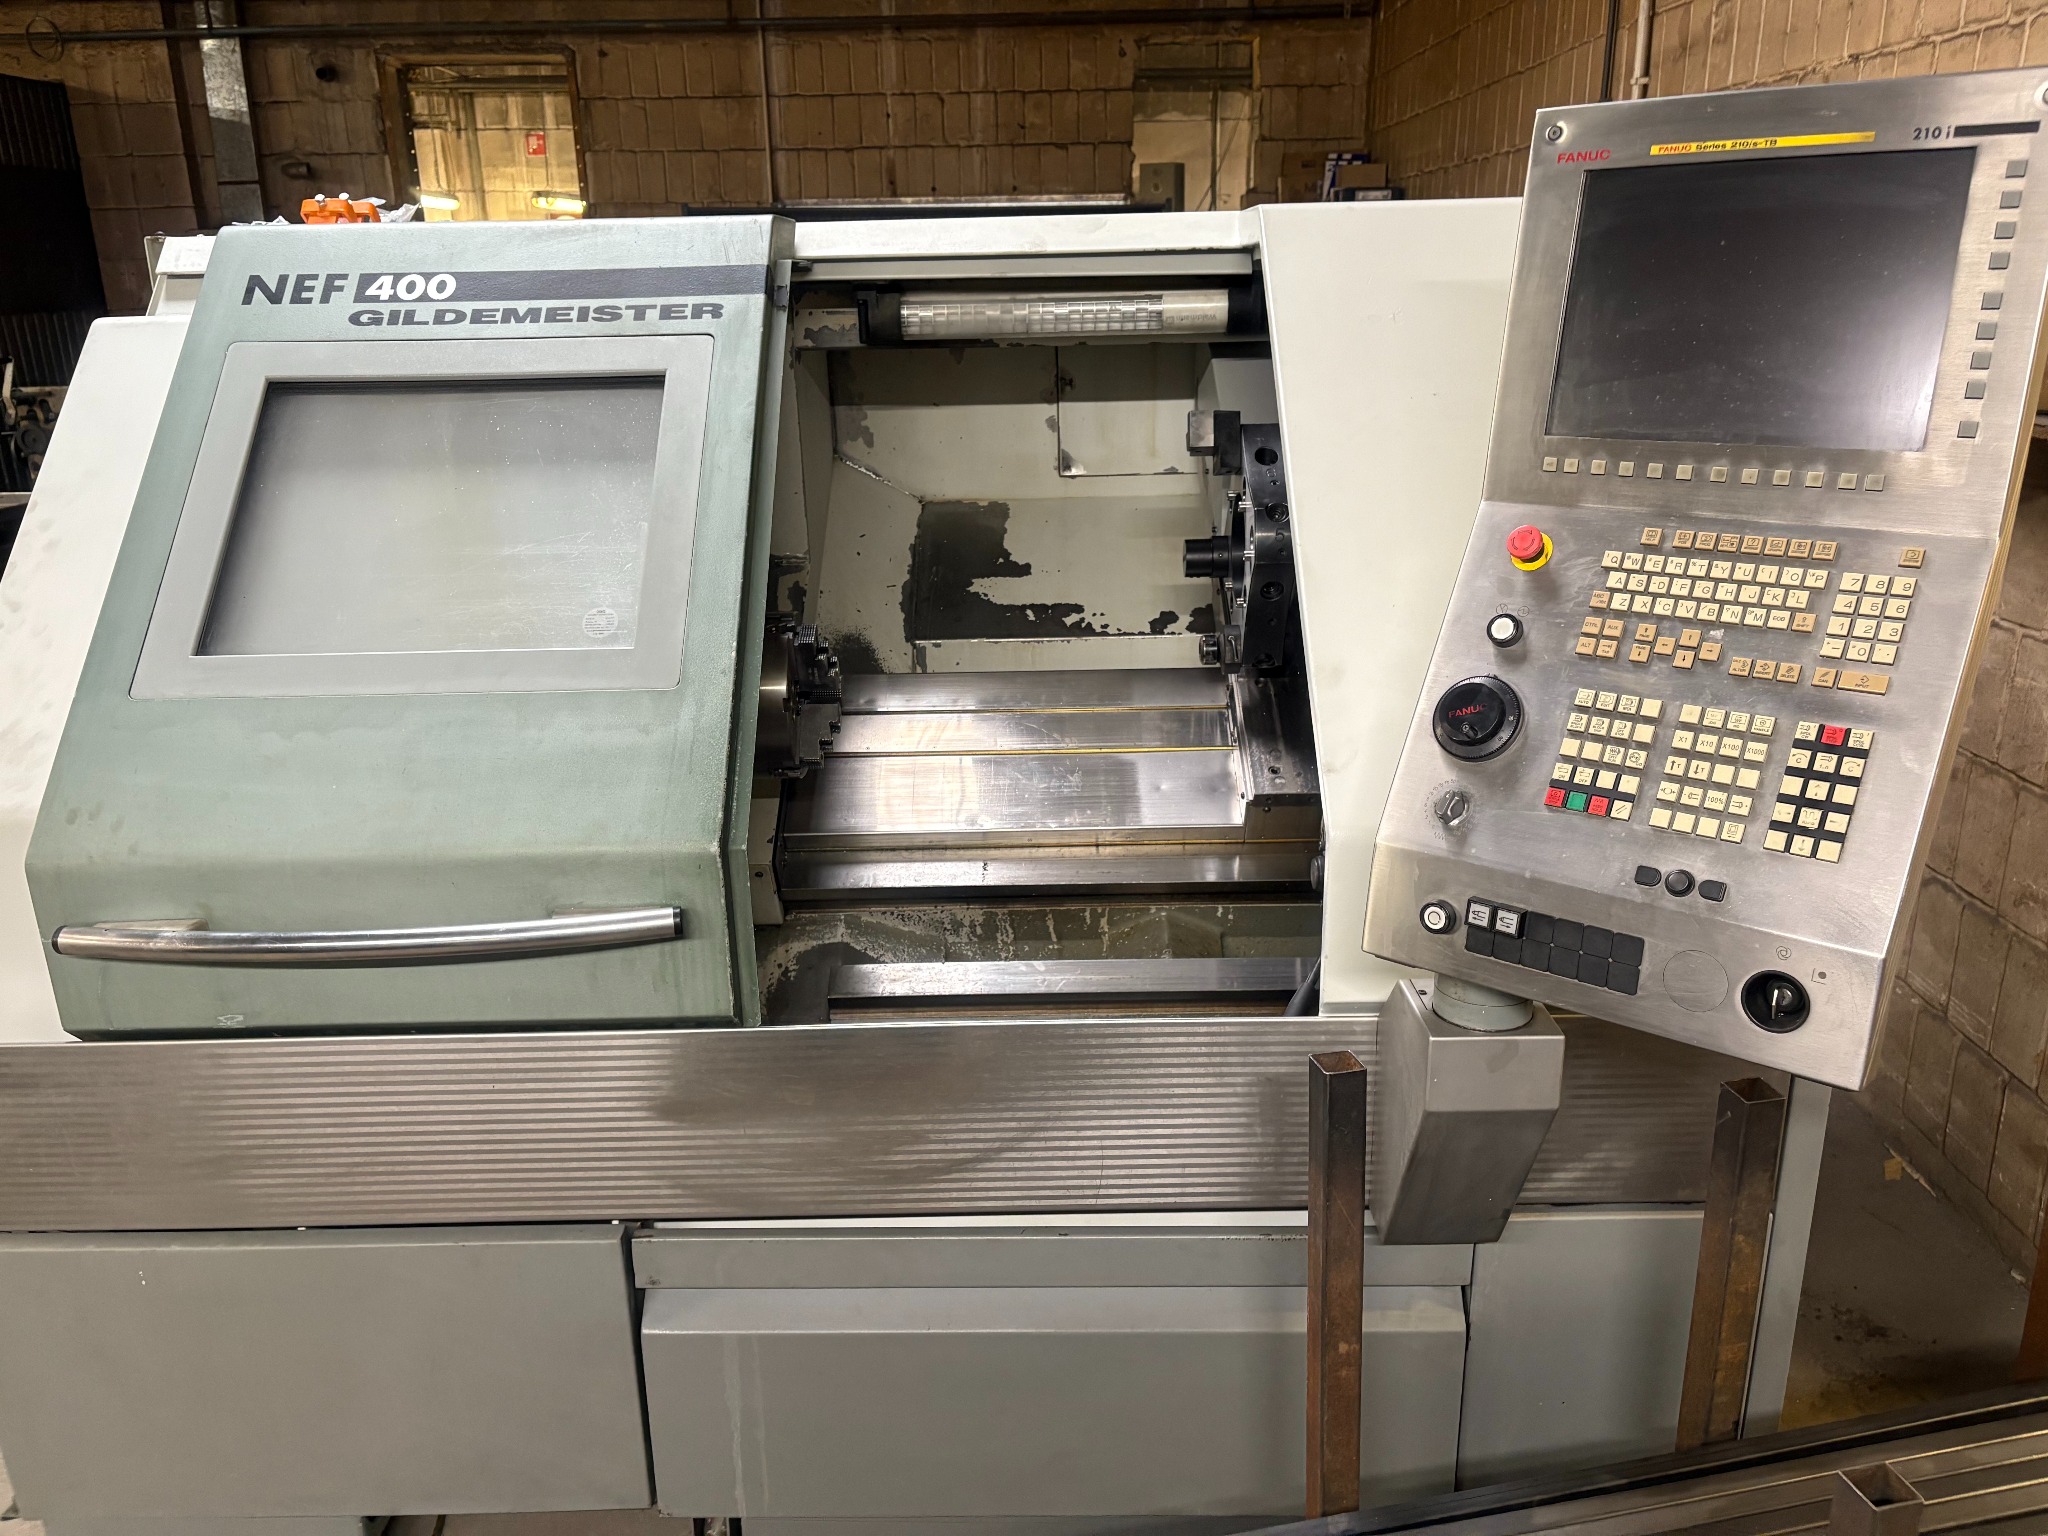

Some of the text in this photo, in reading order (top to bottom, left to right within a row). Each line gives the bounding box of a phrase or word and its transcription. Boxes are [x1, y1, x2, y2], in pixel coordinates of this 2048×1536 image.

[1657, 144, 1692, 153] FANUC
[1695, 141, 1727, 151] Series
[1557, 149, 1611, 164] FANUC
[241, 274, 457, 305] NEF 400
[348, 303, 724, 327] GILDEMEISTER
[1611, 556, 1618, 564] Q
[1631, 558, 1640, 566] W
[1652, 560, 1661, 568] E
[1674, 562, 1682, 570] R
[1698, 564, 1706, 572] T
[1720, 566, 1728, 574] Y
[1743, 568, 1752, 576] U
[1615, 577, 1622, 585] A
[1790, 572, 1800, 582] O
[1814, 574, 1824, 584] P
[1636, 580, 1644, 588] S
[1658, 582, 1666, 590] D
[1850, 578, 1860, 587] 7
[1876, 580, 1885, 590] 8
[1902, 582, 1912, 592] 9
[1680, 584, 1688, 592] F
[1702, 586, 1710, 594] G
[1724, 588, 1733, 597] H
[1748, 591, 1756, 599] J
[1772, 593, 1780, 602] K
[1619, 598, 1627, 607] Z
[1640, 600, 1648, 609] X
[1796, 596, 1803, 604] L
[1662, 603, 1671, 612] C
[1844, 600, 1853, 610] 4
[1870, 602, 1880, 612] 5
[1896, 604, 1906, 614] 6
[1686, 606, 1694, 614] V
[1707, 608, 1716, 616] B
[1730, 610, 1739, 619] N
[1753, 613, 1763, 622] M
[1838, 622, 1845, 631] 1
[1863, 625, 1873, 634] 2
[1889, 628, 1899, 637] 3
[1857, 647, 1867, 656] 0
[1449, 703, 1488, 718] FANUC
[1700, 738, 1714, 747] X10
[1722, 743, 1740, 751] X100
[1747, 747, 1764, 756] X1000
[1707, 796, 1724, 804] 100%
